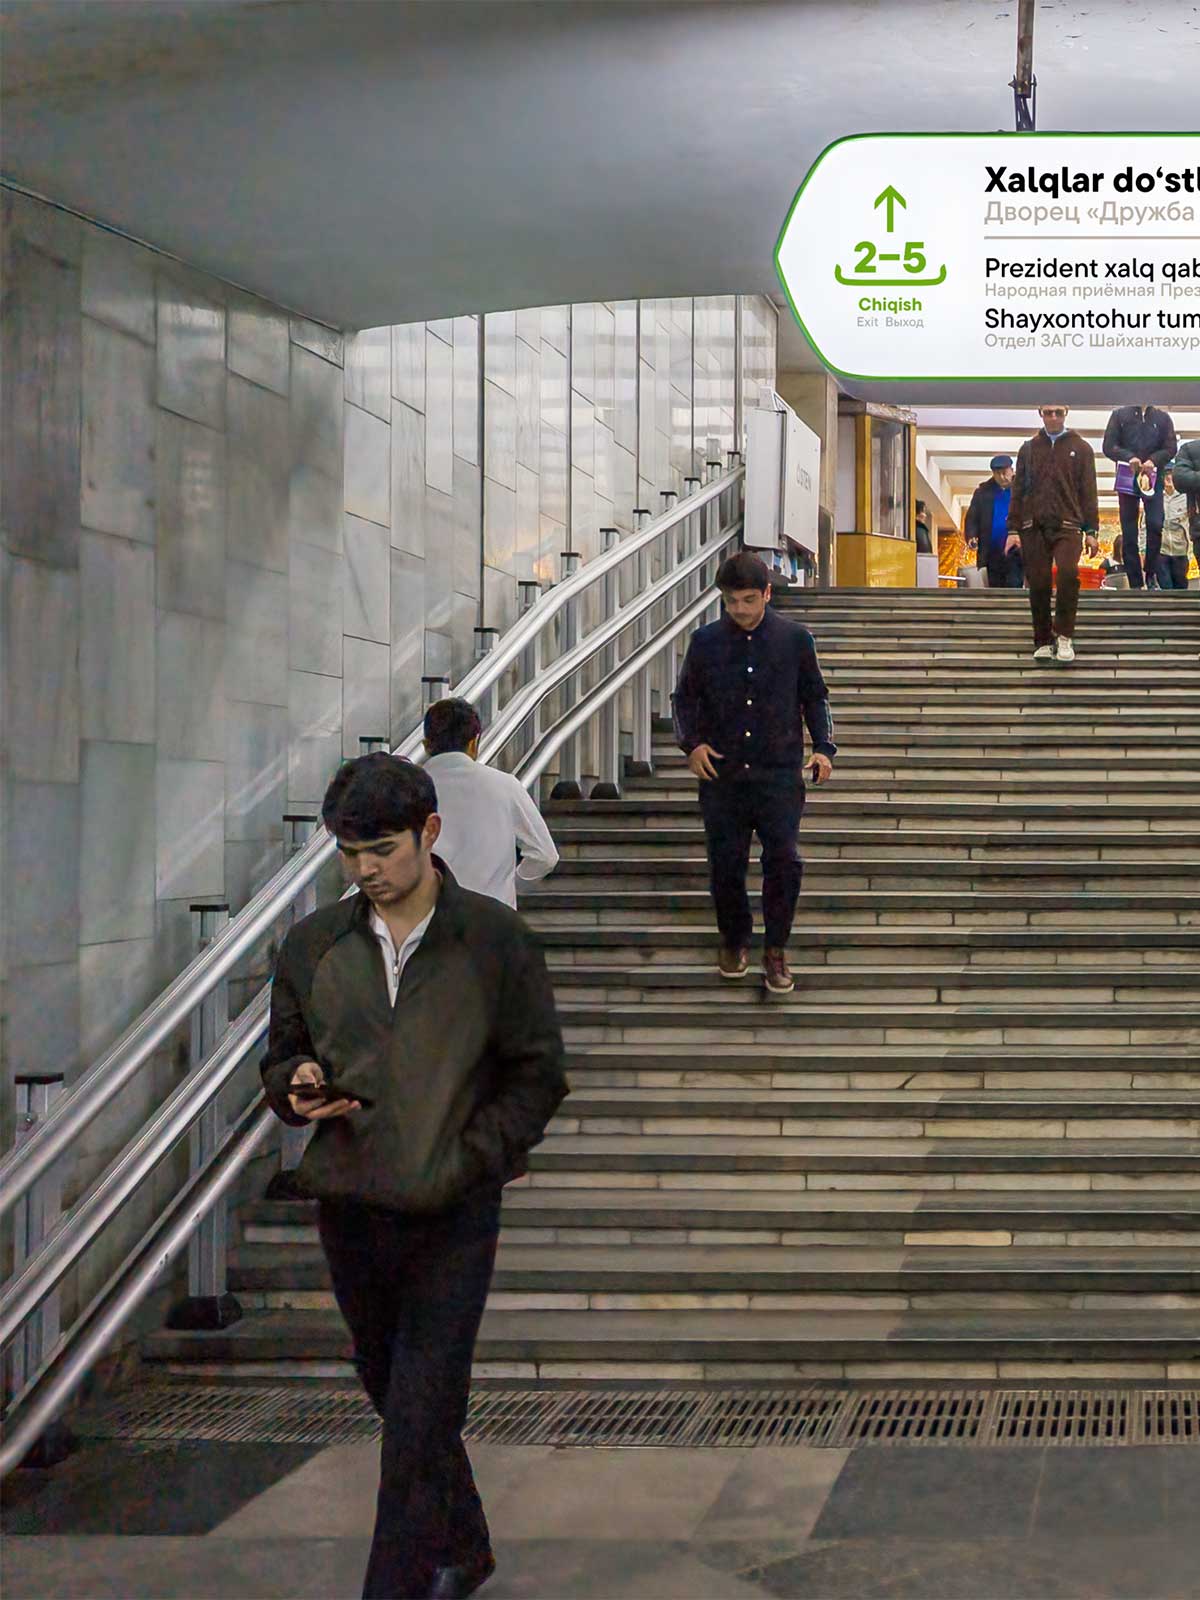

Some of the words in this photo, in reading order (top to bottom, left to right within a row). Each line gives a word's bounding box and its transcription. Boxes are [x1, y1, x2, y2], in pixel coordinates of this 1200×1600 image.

[984, 166, 1105, 199] Xalqlar
[984, 201, 1081, 225] Дворец
[1087, 201, 1195, 226] «Дружба
[985, 258, 1098, 278] Prezident
[1104, 258, 1154, 282] xalq
[985, 283, 1067, 298] Народная
[1072, 282, 1155, 298] приёмная
[858, 297, 922, 314] Chiqish
[857, 316, 879, 327] Exit
[885, 316, 925, 328] Выход
[984, 308, 1151, 333] Shayxontohur
[985, 334, 1036, 349] Отдел
[1040, 334, 1084, 347] ЗАГС
